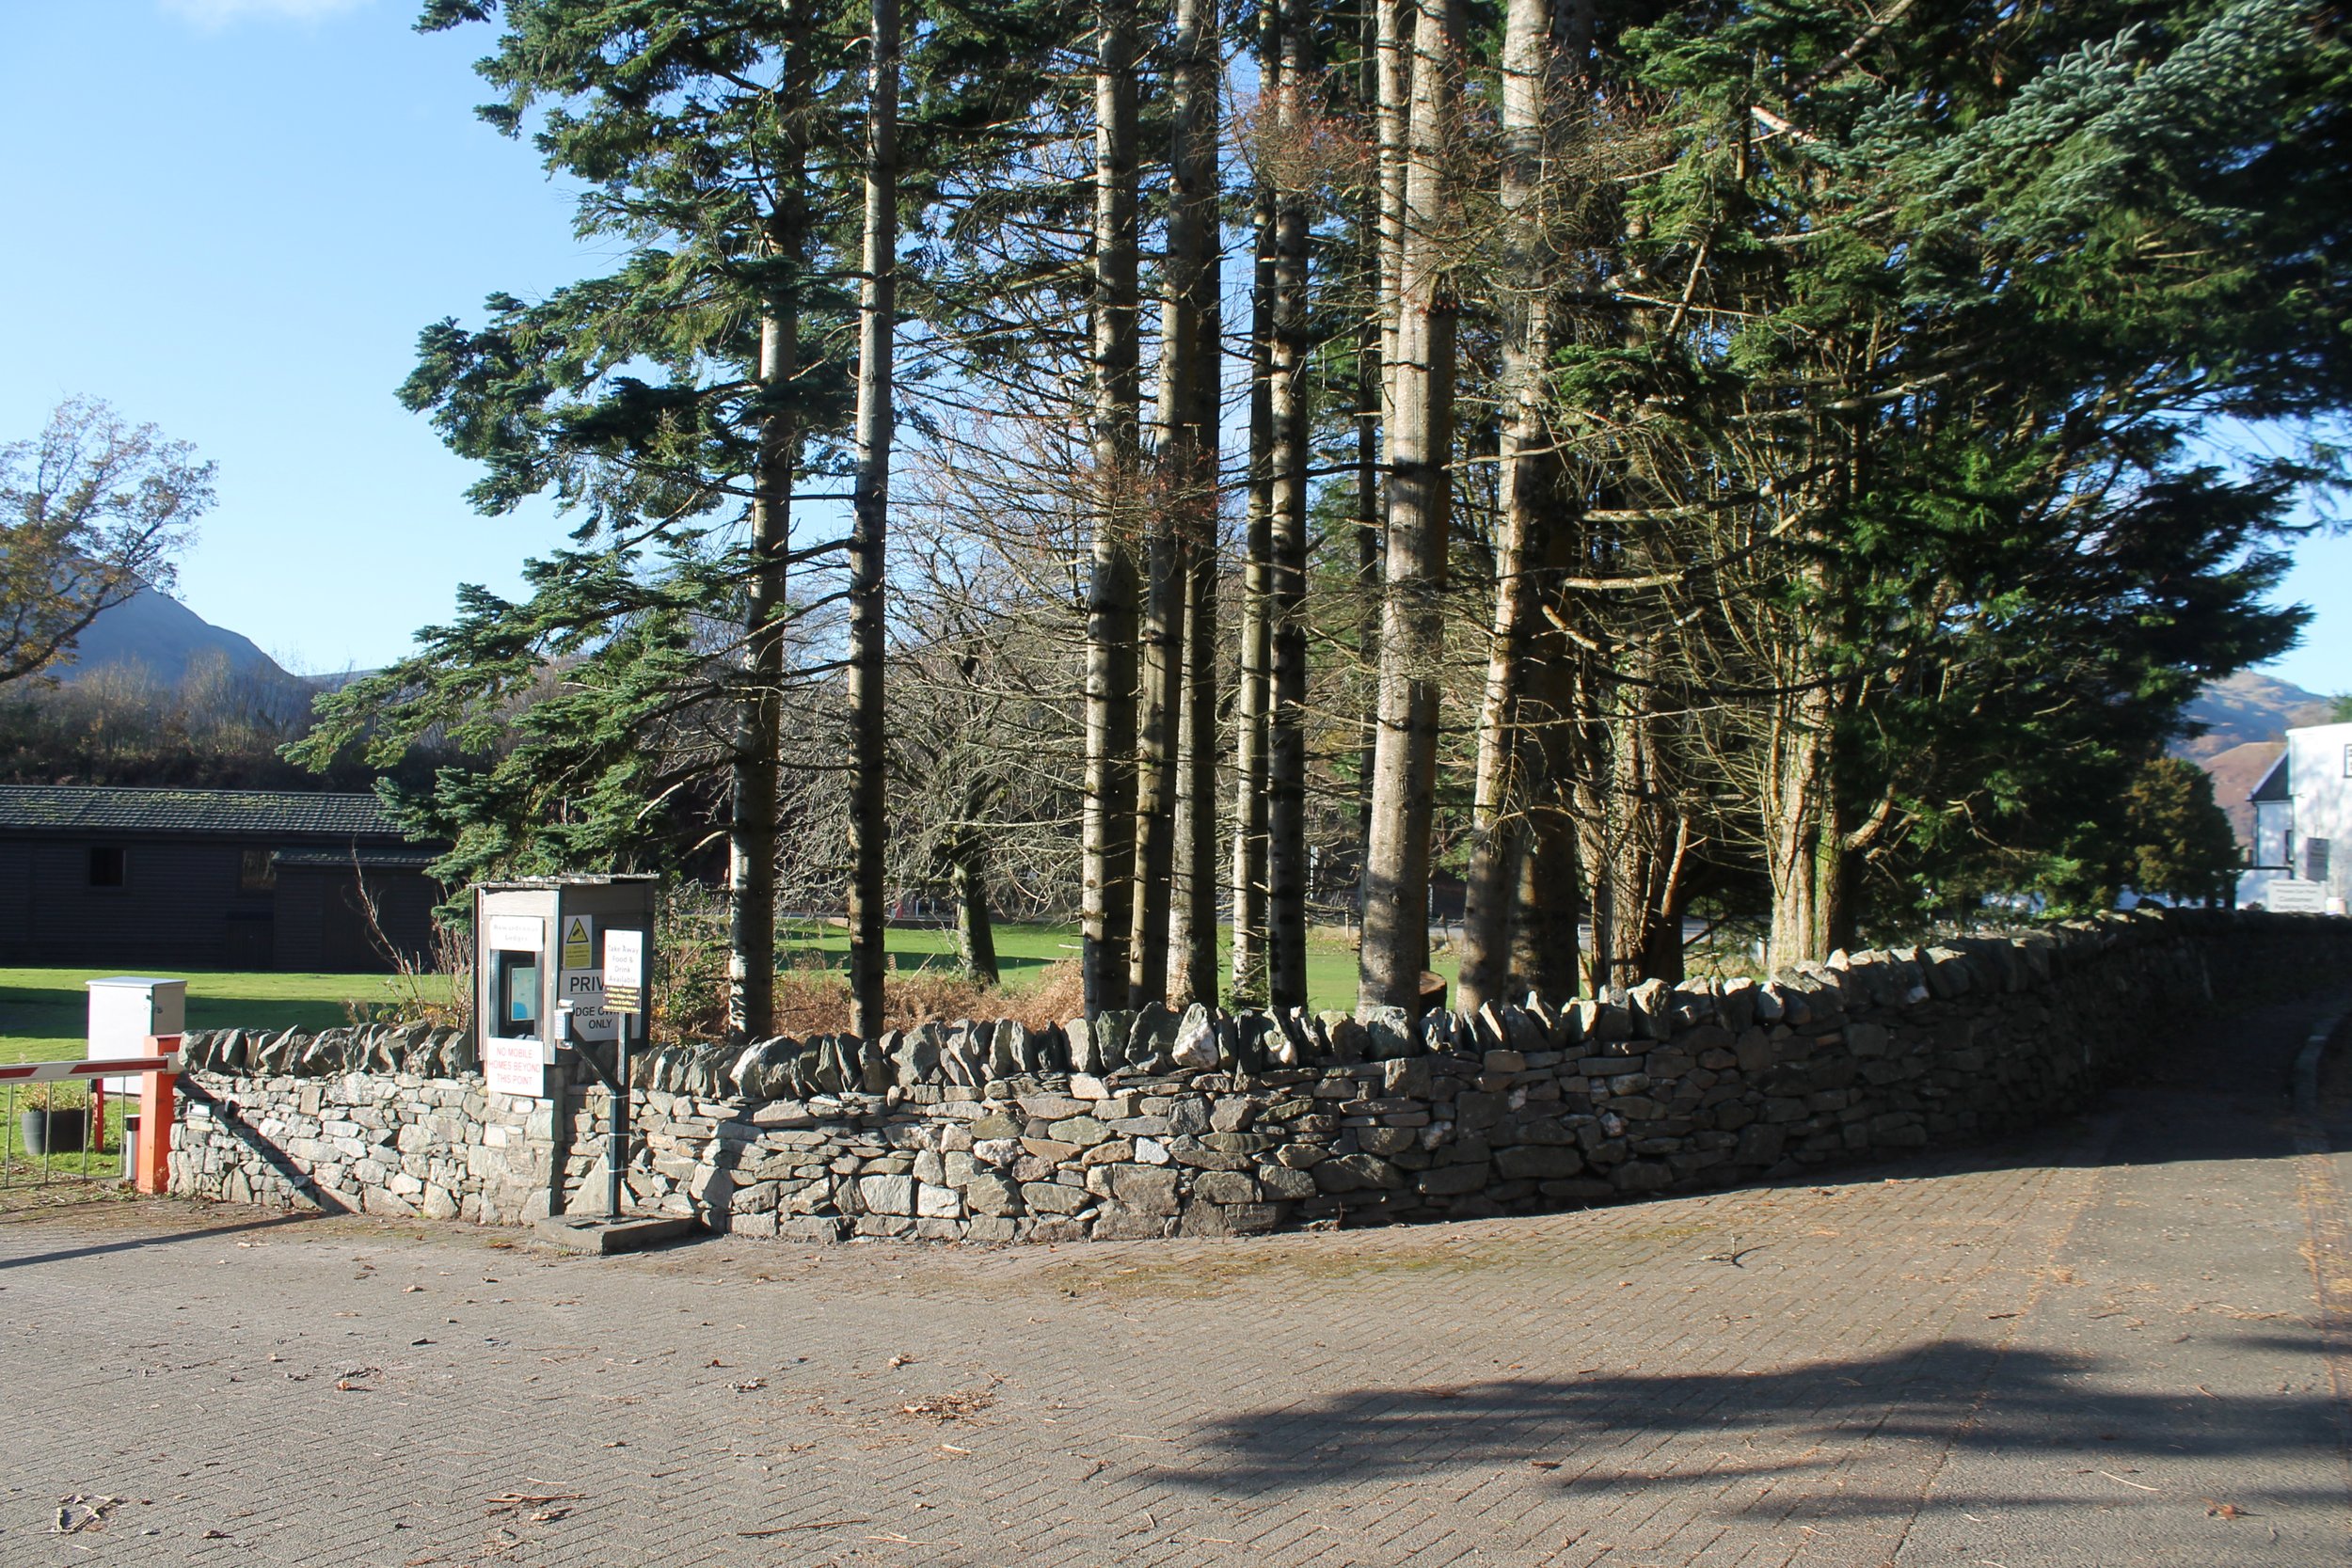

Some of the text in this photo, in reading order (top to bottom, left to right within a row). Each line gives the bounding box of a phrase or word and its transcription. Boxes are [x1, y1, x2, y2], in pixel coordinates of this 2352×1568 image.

[622, 944, 639, 955] Away
[570, 976, 603, 991] PRIV
[574, 1006, 596, 1017] DGE
[588, 1020, 612, 1029] ONLY
[496, 1046, 532, 1058] NO MOBILE
[488, 1059, 541, 1073] HOMES BEYOND
[497, 1072, 532, 1085] THIS POINT
